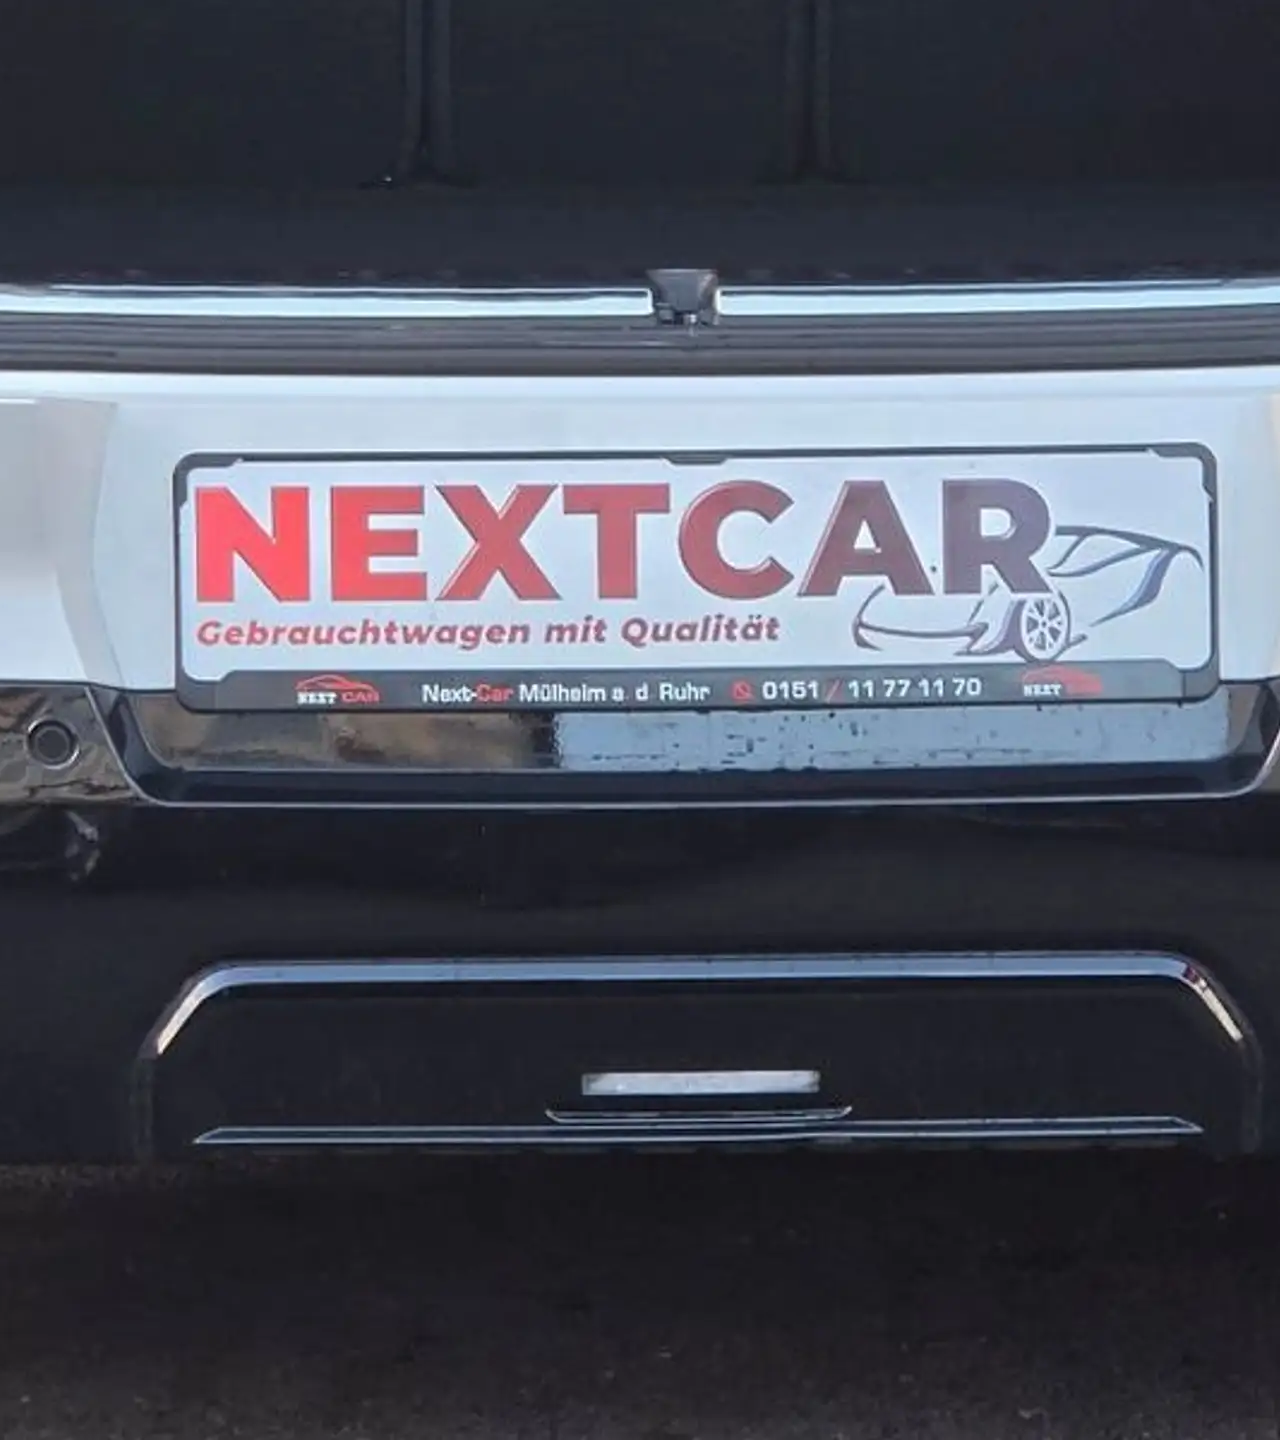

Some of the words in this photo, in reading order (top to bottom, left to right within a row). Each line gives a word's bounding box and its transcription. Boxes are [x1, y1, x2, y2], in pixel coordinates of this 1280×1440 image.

[195, 478, 1052, 602] NEXTCAR
[197, 620, 530, 651] Gebrauchtwagen
[544, 615, 608, 644] mit
[621, 613, 781, 648] Qualität
[519, 683, 607, 702] Mülheim
[659, 682, 710, 701] Ruhr
[762, 680, 819, 700] 0151
[848, 680, 874, 699] 11
[883, 678, 911, 698] 77
[919, 678, 945, 697] 11
[952, 677, 982, 697] 70
